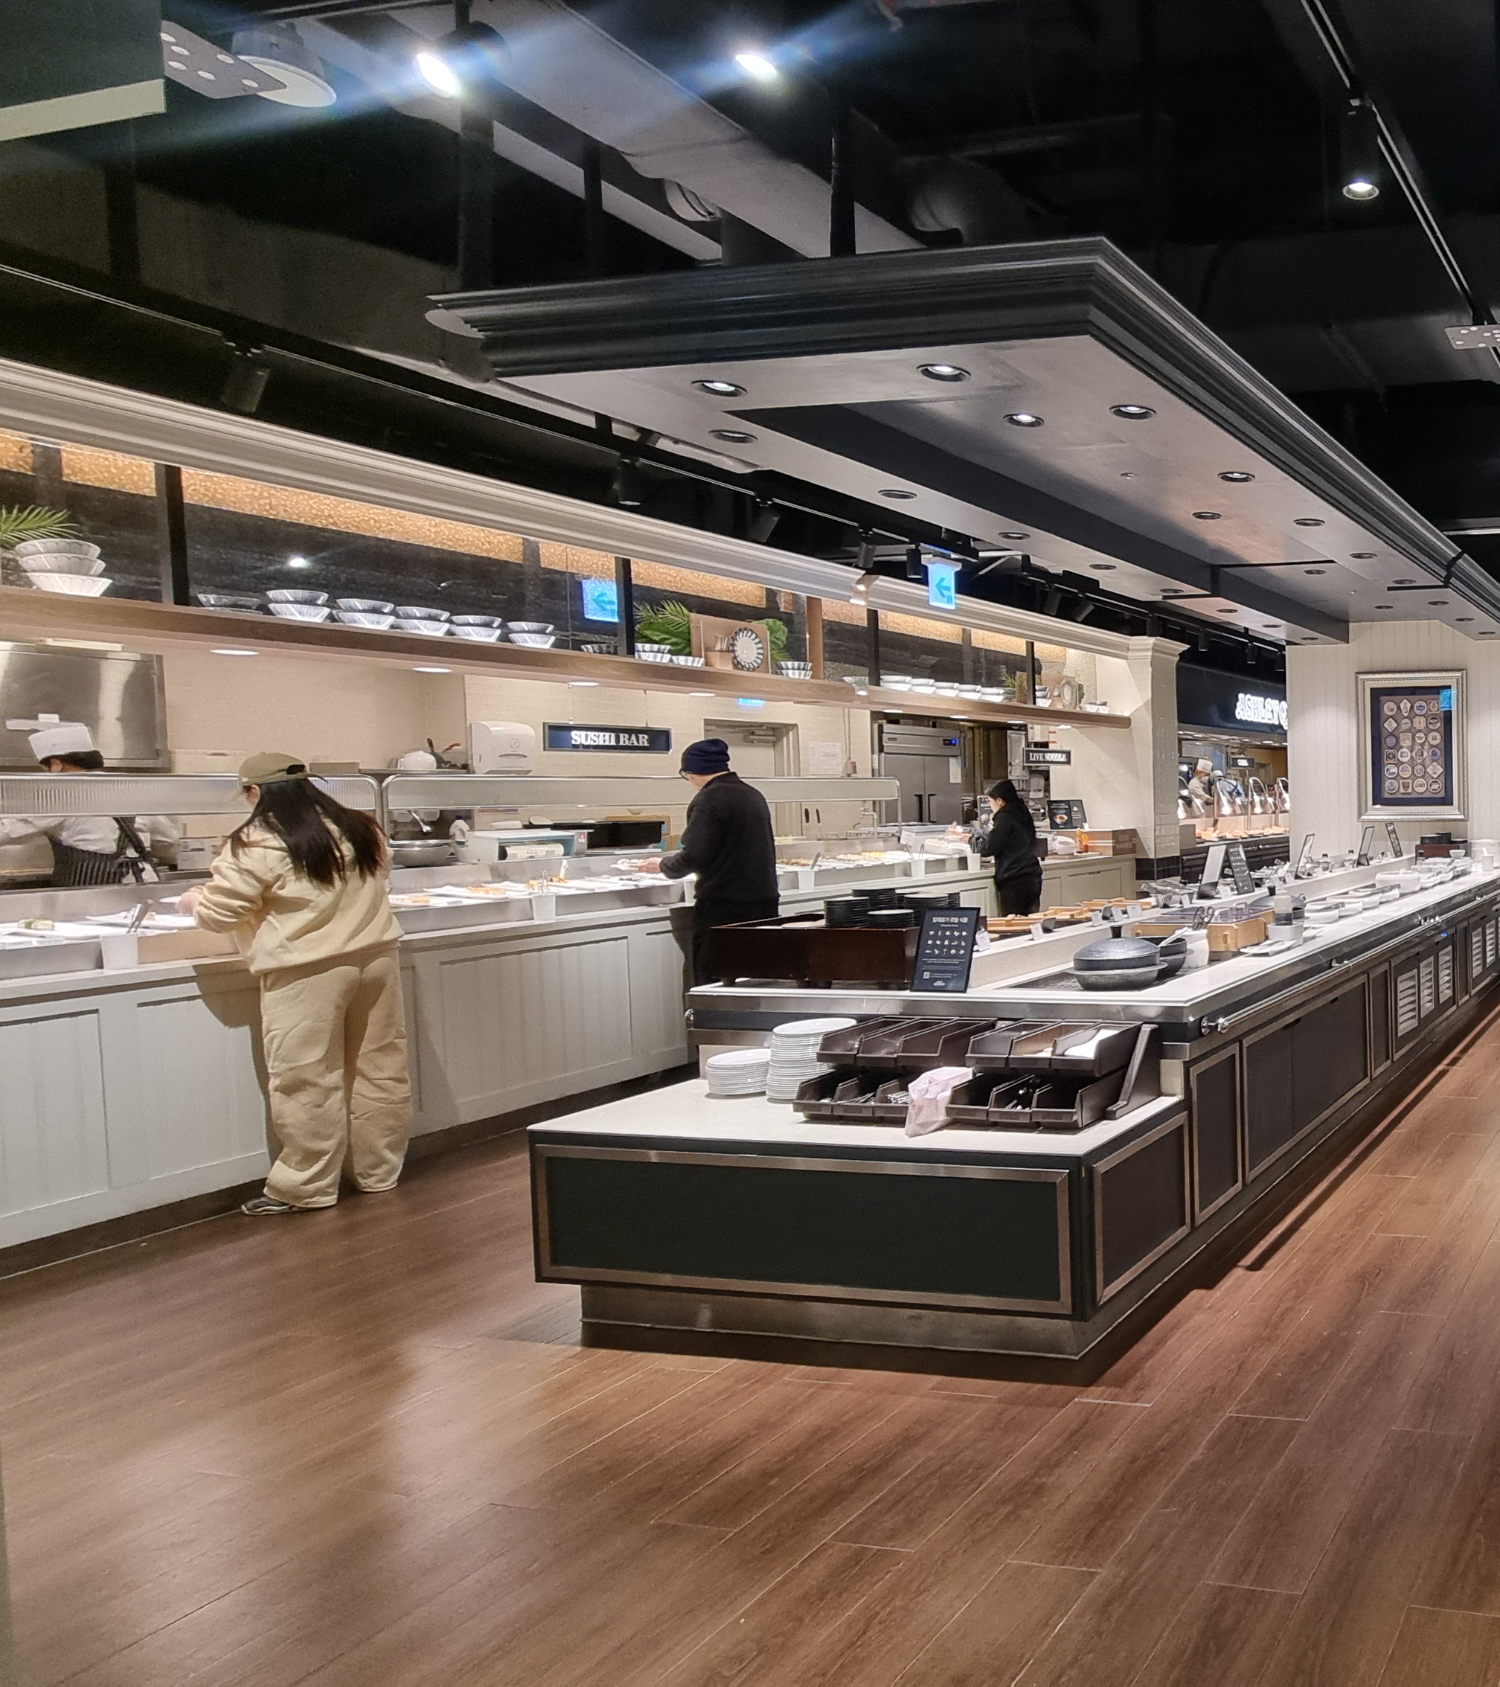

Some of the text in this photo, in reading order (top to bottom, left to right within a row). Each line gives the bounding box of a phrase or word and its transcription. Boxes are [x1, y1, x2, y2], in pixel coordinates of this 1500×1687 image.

[1235, 693, 1280, 725] ASHLEY
[570, 730, 650, 747] SUSHI BAR
